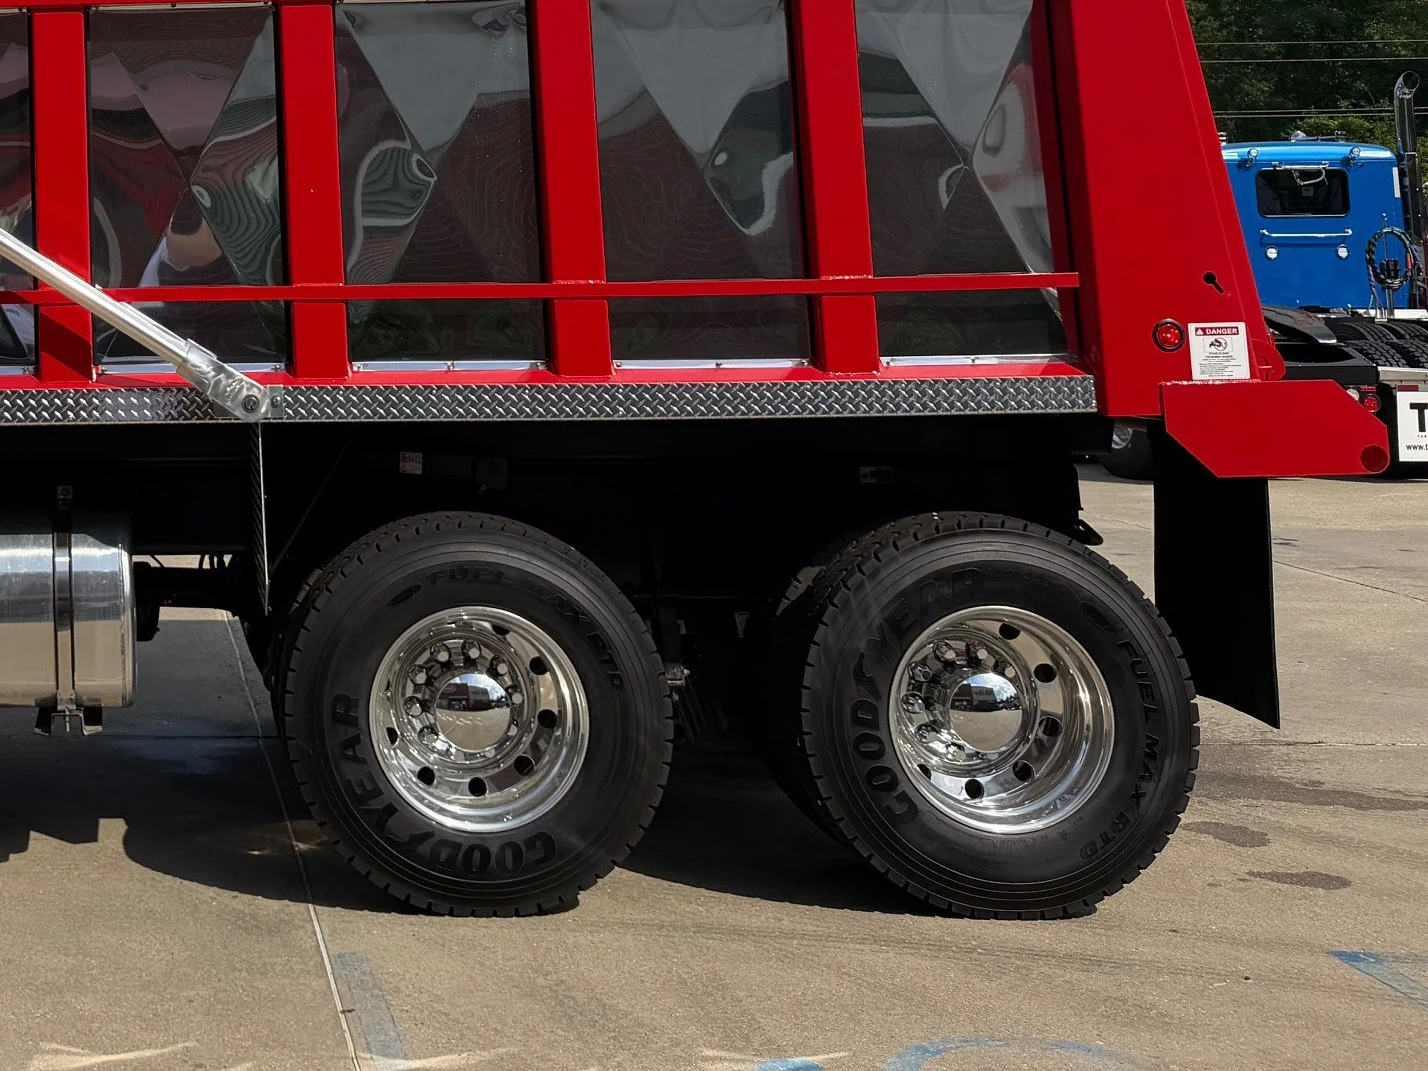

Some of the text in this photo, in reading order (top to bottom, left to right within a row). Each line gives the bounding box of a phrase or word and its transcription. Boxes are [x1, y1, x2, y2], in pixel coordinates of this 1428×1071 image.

[329, 691, 557, 877] GOODYEAR
[850, 565, 986, 826] GOODYEAR
[1078, 638, 1161, 861] FUEL MAX RTD
